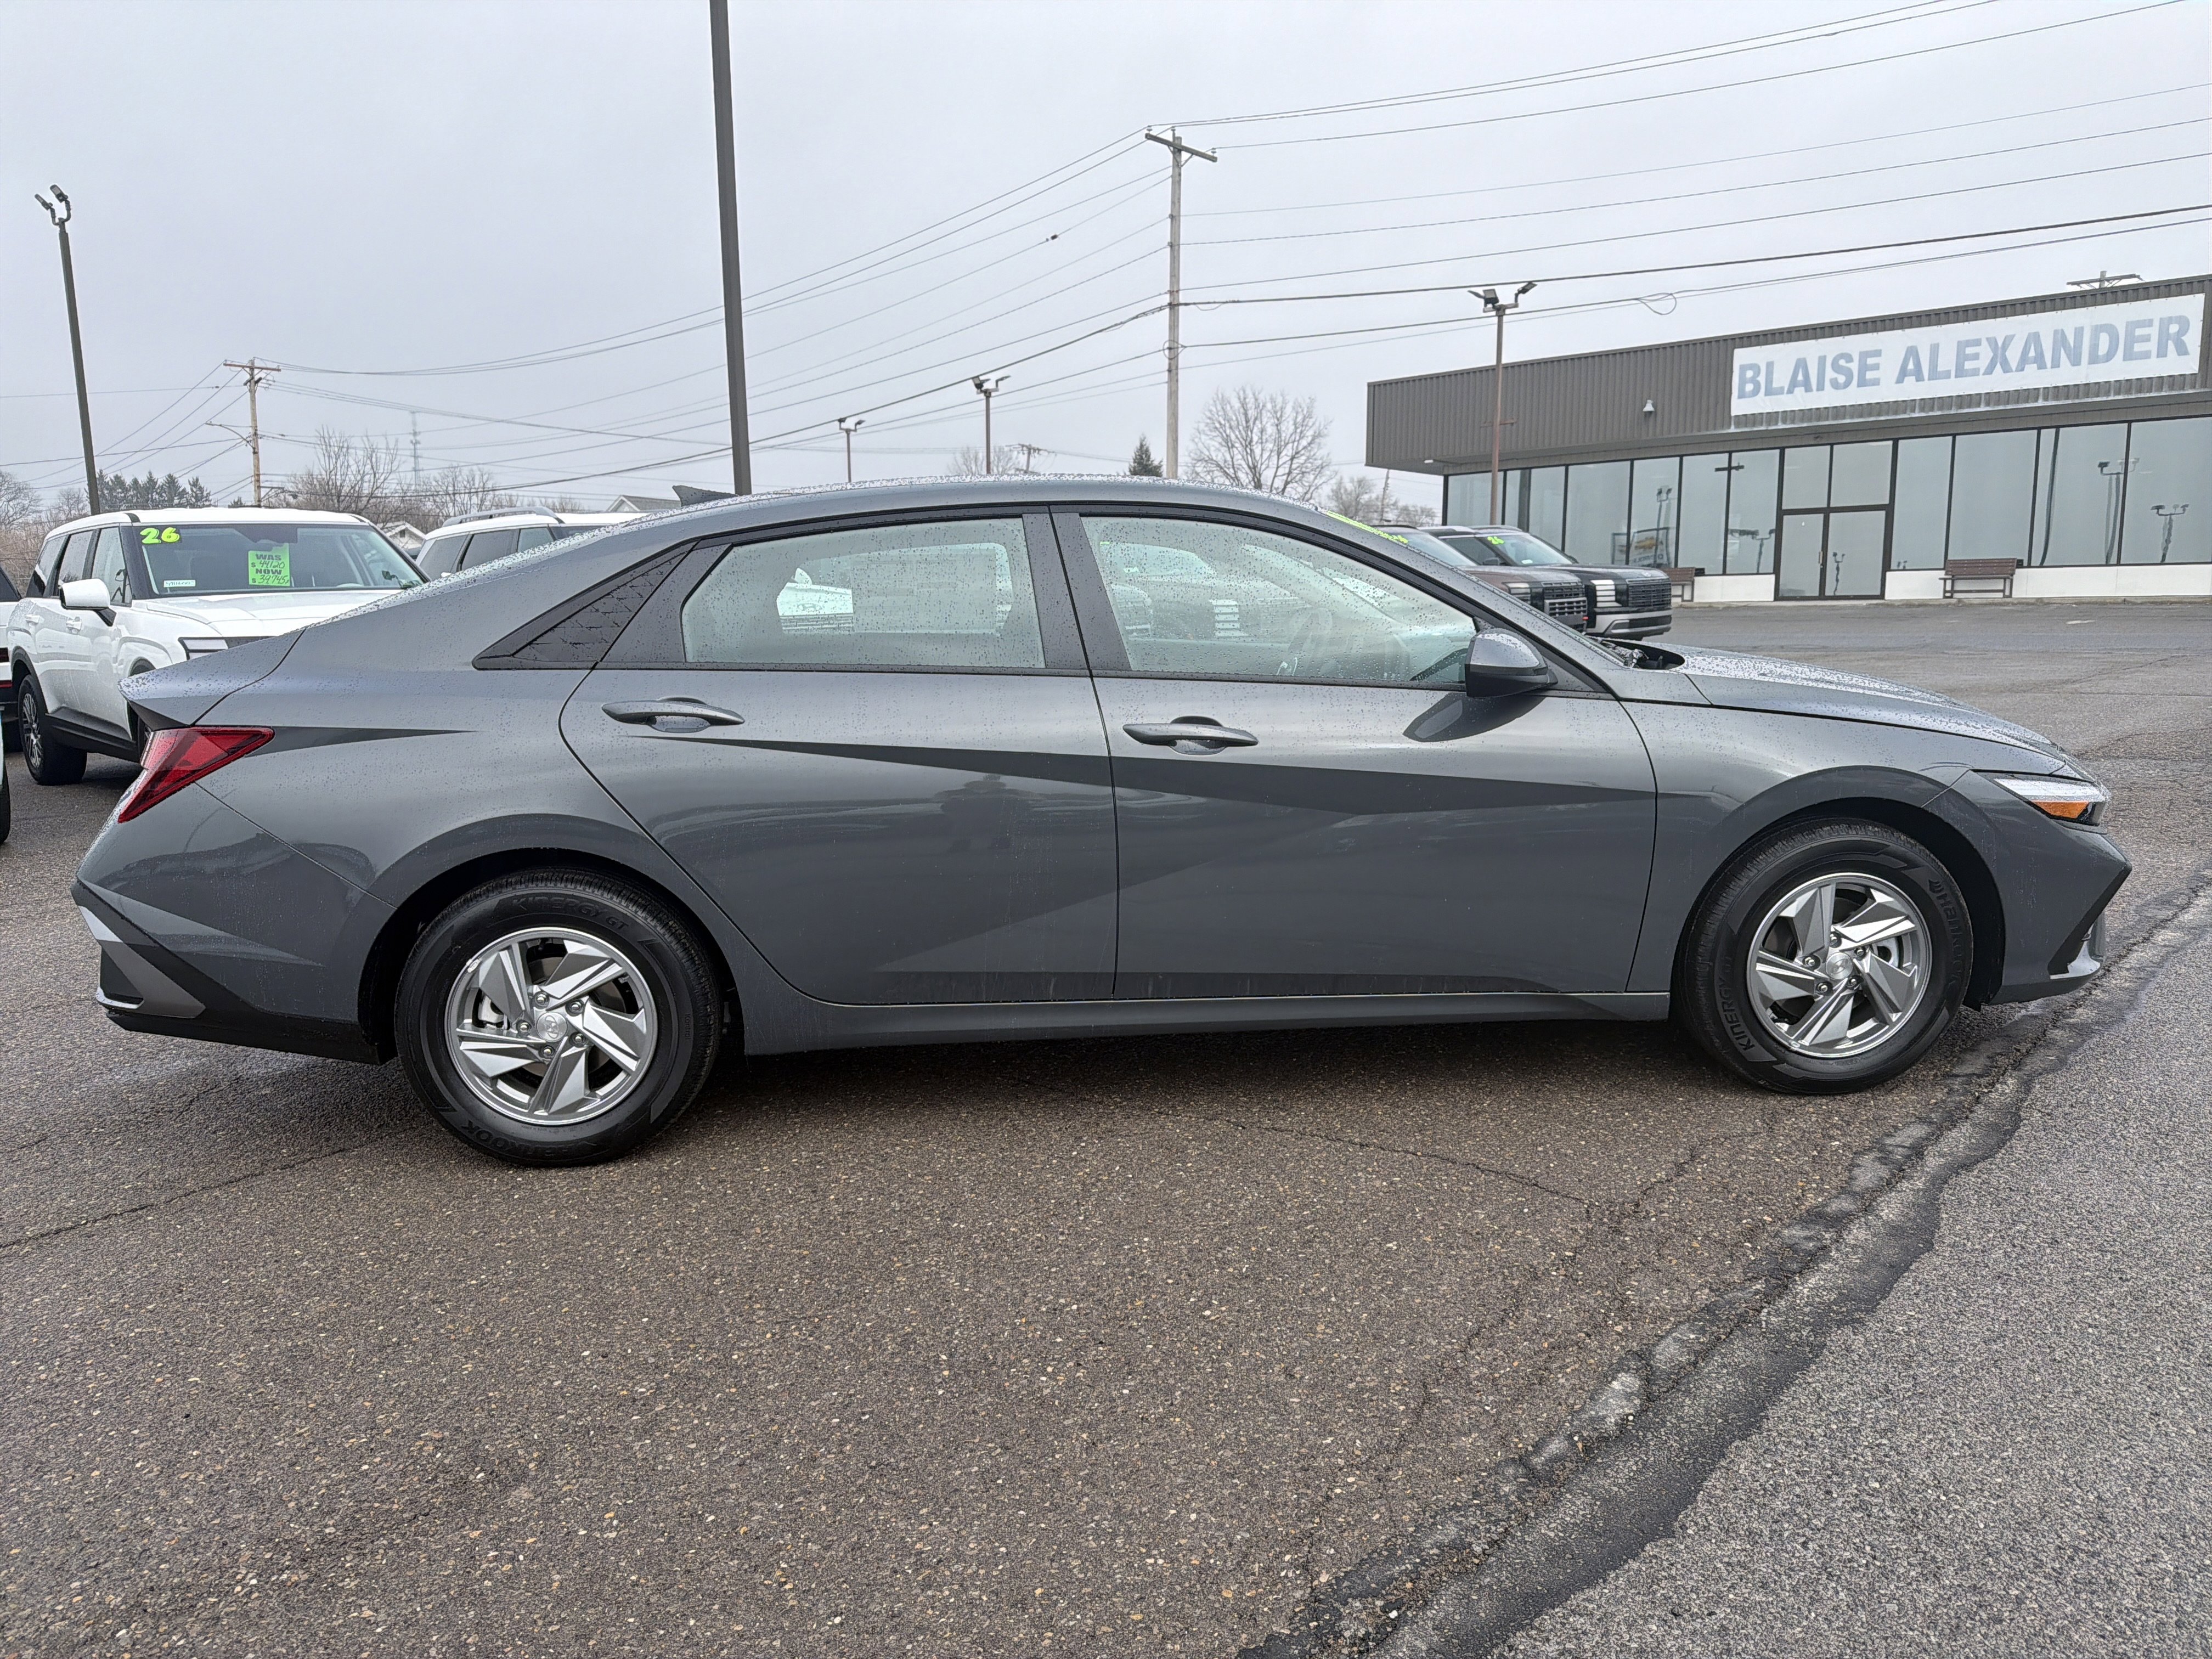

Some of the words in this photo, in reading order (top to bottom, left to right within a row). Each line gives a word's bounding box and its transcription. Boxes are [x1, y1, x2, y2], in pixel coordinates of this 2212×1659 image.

[1737, 349, 1882, 399] BLAISE
[1894, 314, 2191, 384] ALEXANDER
[140, 527, 180, 544] 26
[605, 915, 629, 931] GT
[1719, 975, 1756, 1051] KINERGY
